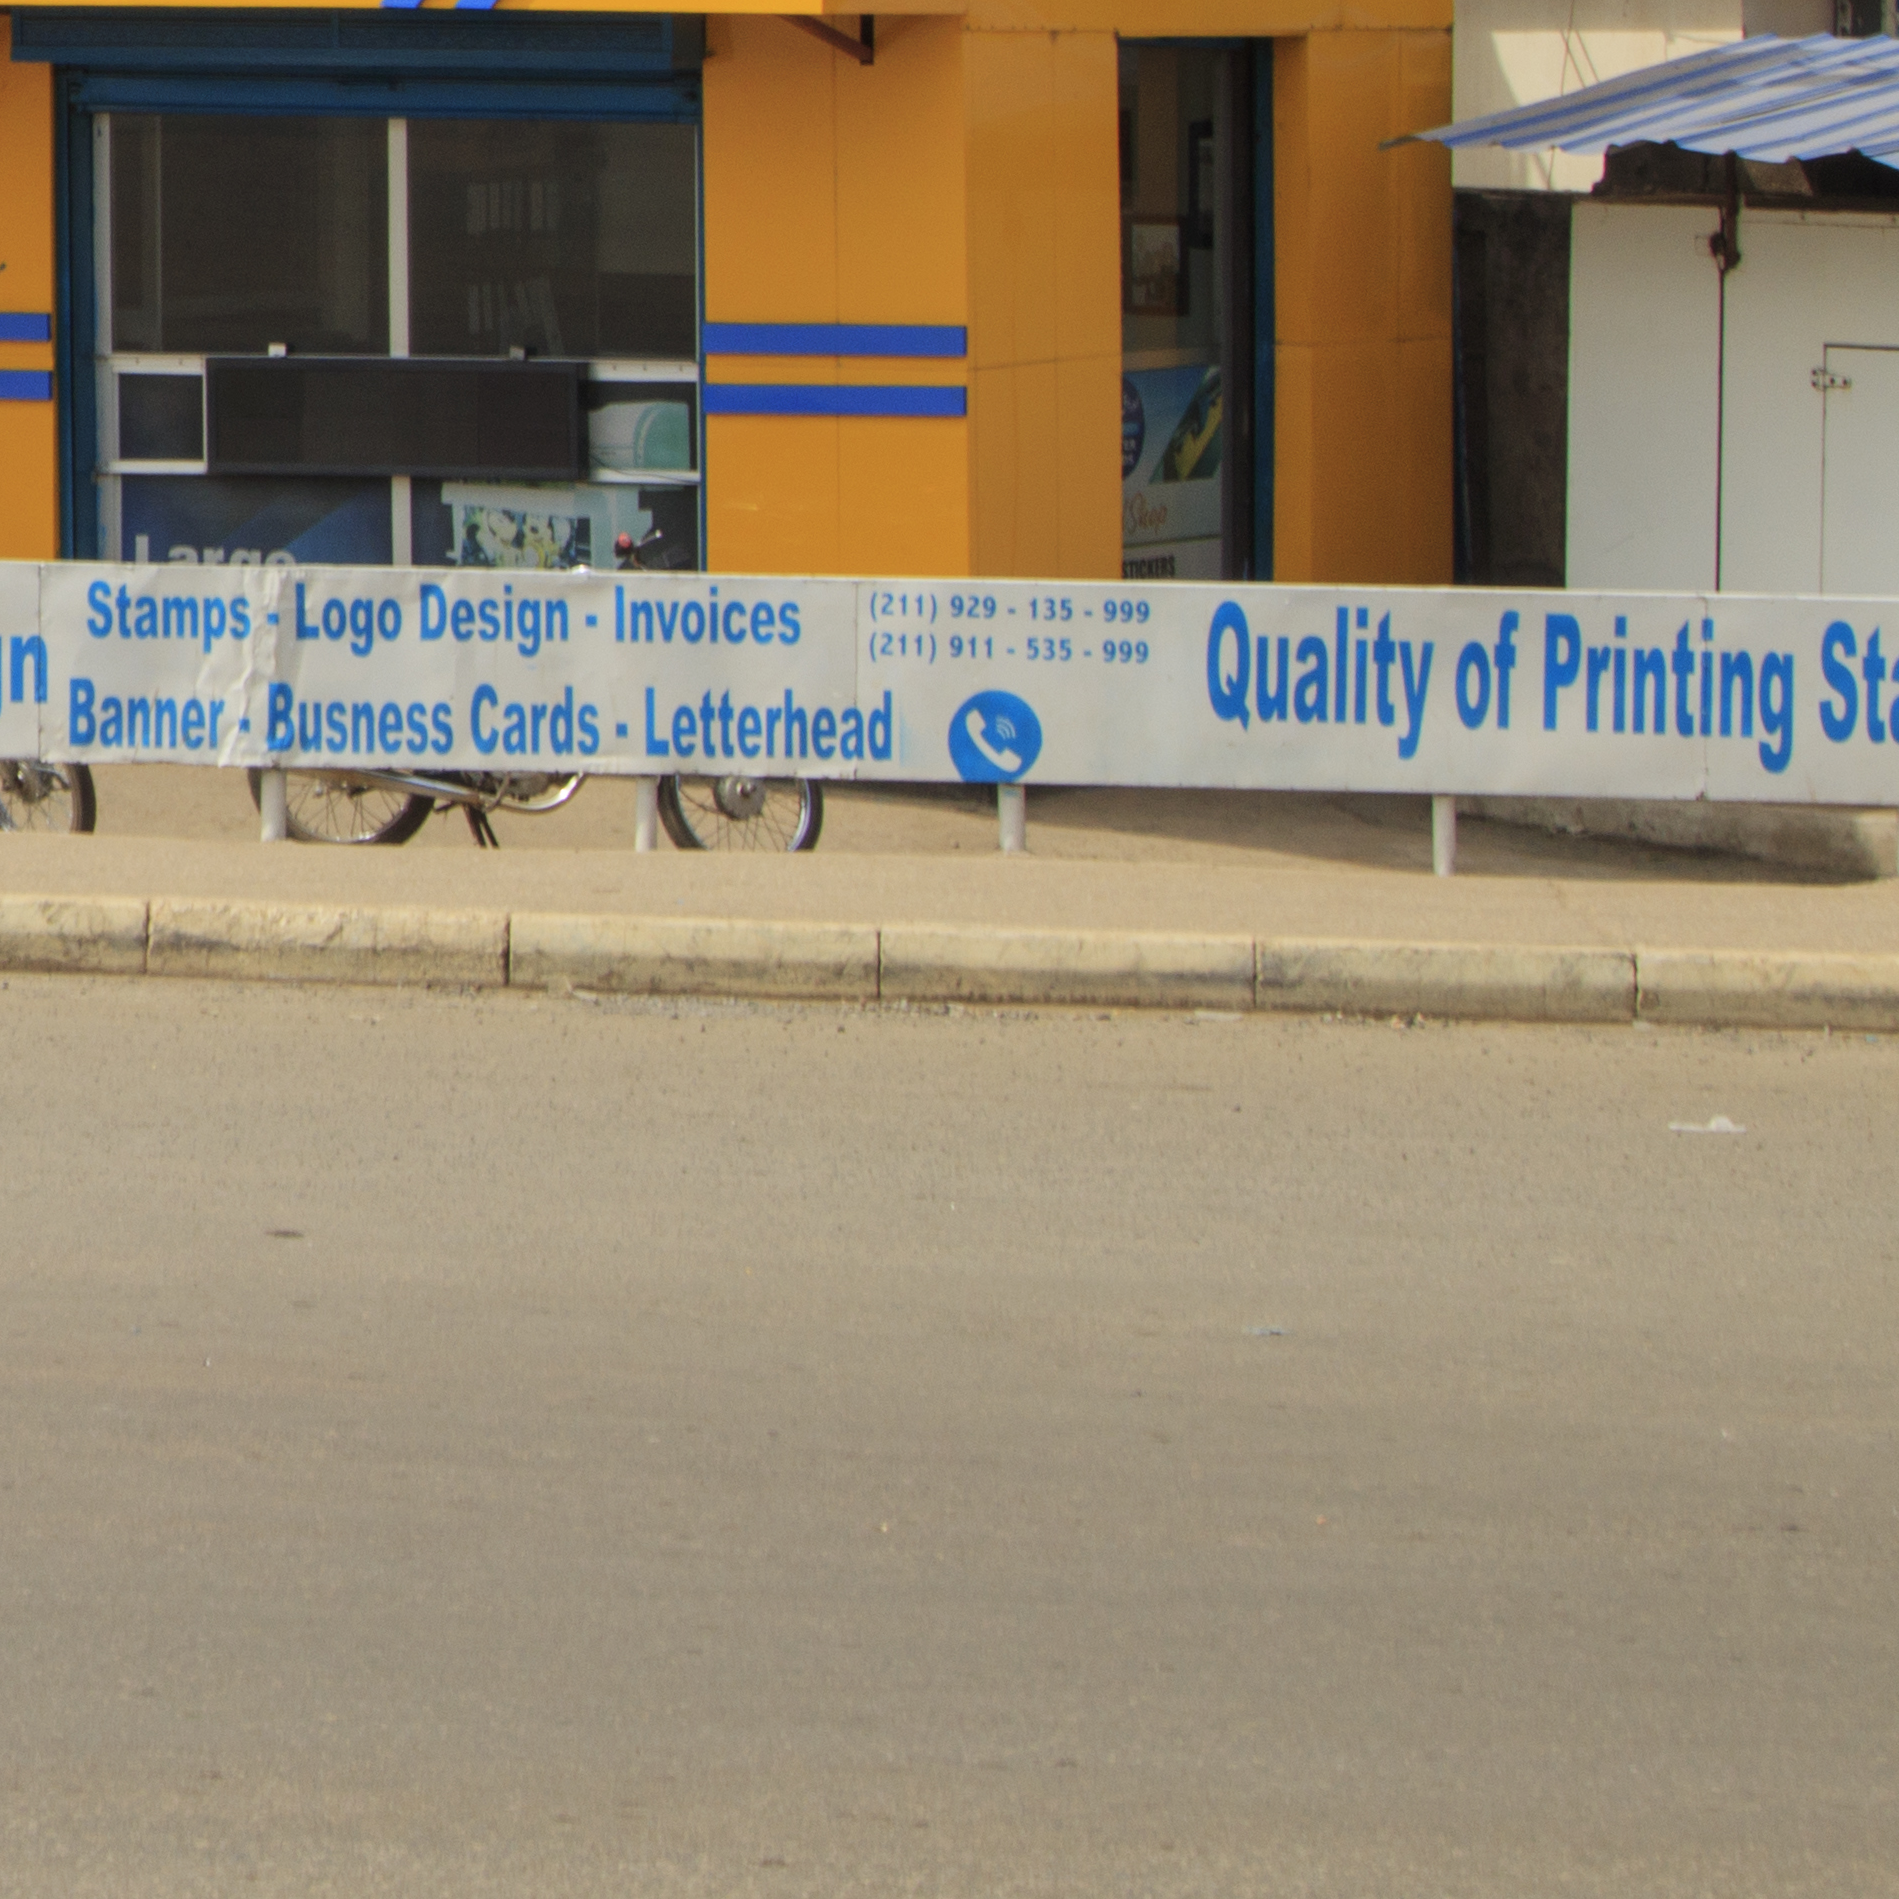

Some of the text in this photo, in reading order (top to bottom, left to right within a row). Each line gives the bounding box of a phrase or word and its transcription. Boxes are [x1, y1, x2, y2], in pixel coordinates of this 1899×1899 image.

[87, 579, 252, 655] Stamps
[295, 582, 404, 660] Logo
[419, 583, 571, 660] Design
[614, 584, 804, 647] Invoices
[869, 631, 938, 665] (211)
[950, 634, 995, 659] 911
[1026, 637, 1074, 662] 535
[1102, 639, 1152, 665] 999
[870, 591, 939, 624] (211)
[950, 594, 998, 620] 929
[1029, 596, 1075, 623] 135
[1102, 598, 1152, 625] 999
[68, 676, 227, 751] Banner
[265, 681, 455, 756] Busness
[470, 683, 603, 757] Cards
[644, 686, 895, 763] Letterhead
[1206, 599, 1438, 762] Quality
[1455, 609, 1524, 732] of
[1543, 612, 1796, 776] Printing
